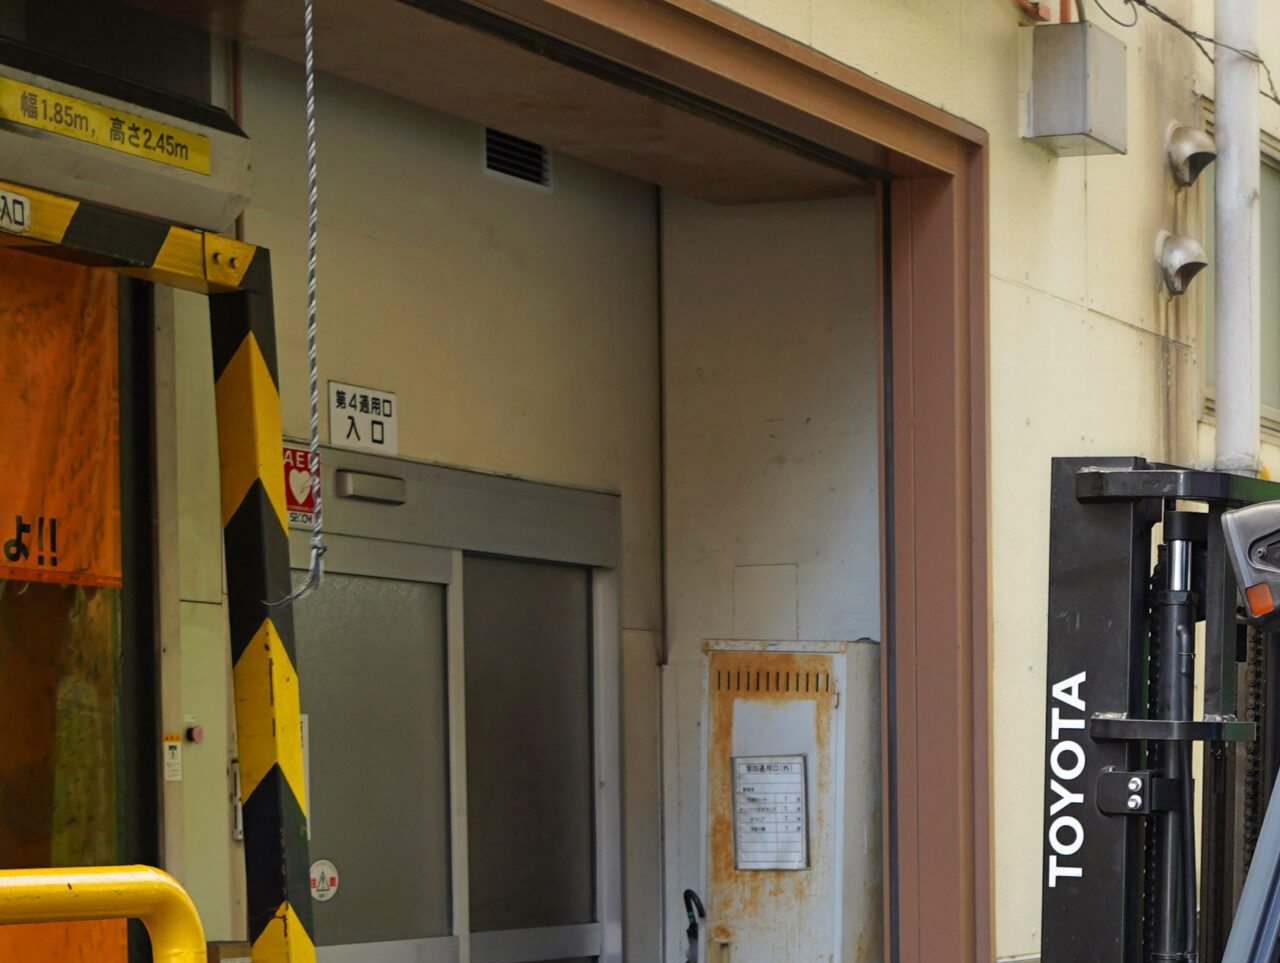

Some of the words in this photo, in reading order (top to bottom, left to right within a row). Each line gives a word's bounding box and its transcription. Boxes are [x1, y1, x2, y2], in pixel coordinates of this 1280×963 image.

[109, 116, 189, 161] 高さ2.45m
[336, 390, 392, 418] 第4通用口
[346, 415, 385, 445] 入口
[1048, 670, 1087, 887] TOYOTA
